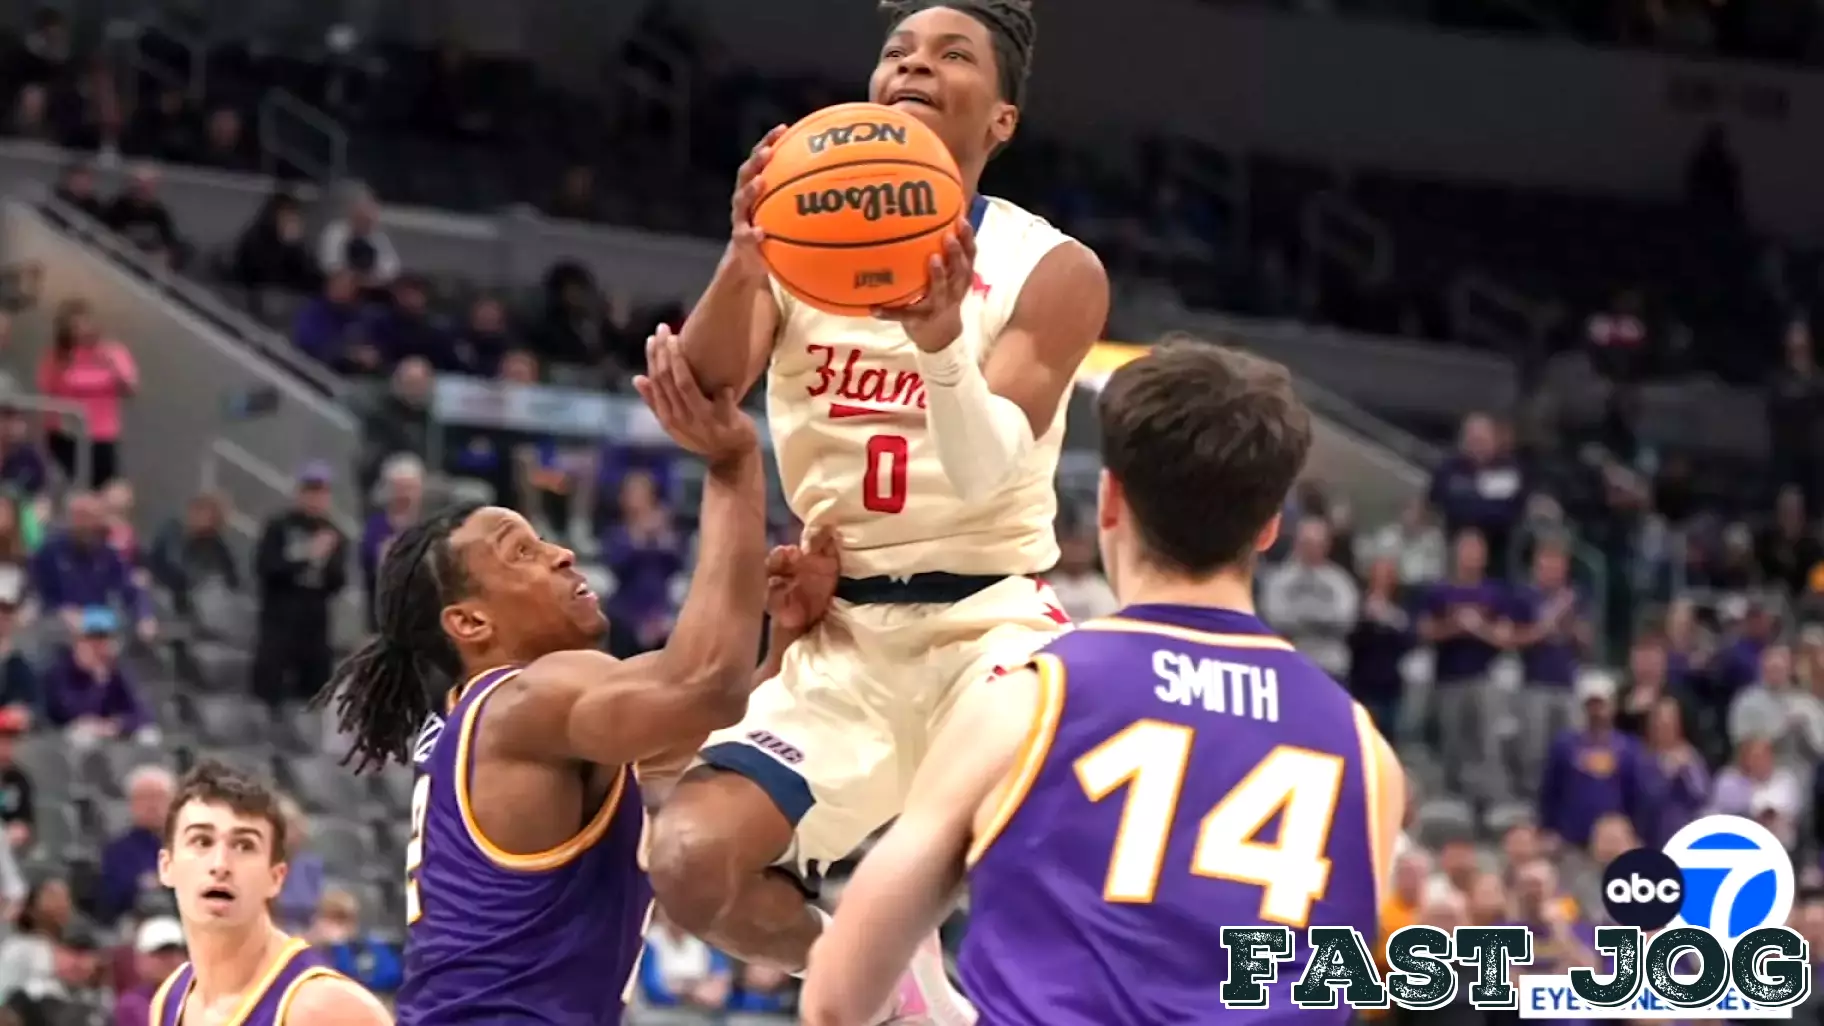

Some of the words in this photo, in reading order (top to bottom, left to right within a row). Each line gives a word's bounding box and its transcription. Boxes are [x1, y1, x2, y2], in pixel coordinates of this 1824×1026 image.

[807, 122, 906, 152] NCAA
[795, 179, 938, 221] Wilson
[805, 344, 927, 409] Flam
[863, 434, 908, 514] 0
[1151, 649, 1279, 722] SMITH
[1072, 717, 1345, 929] 14
